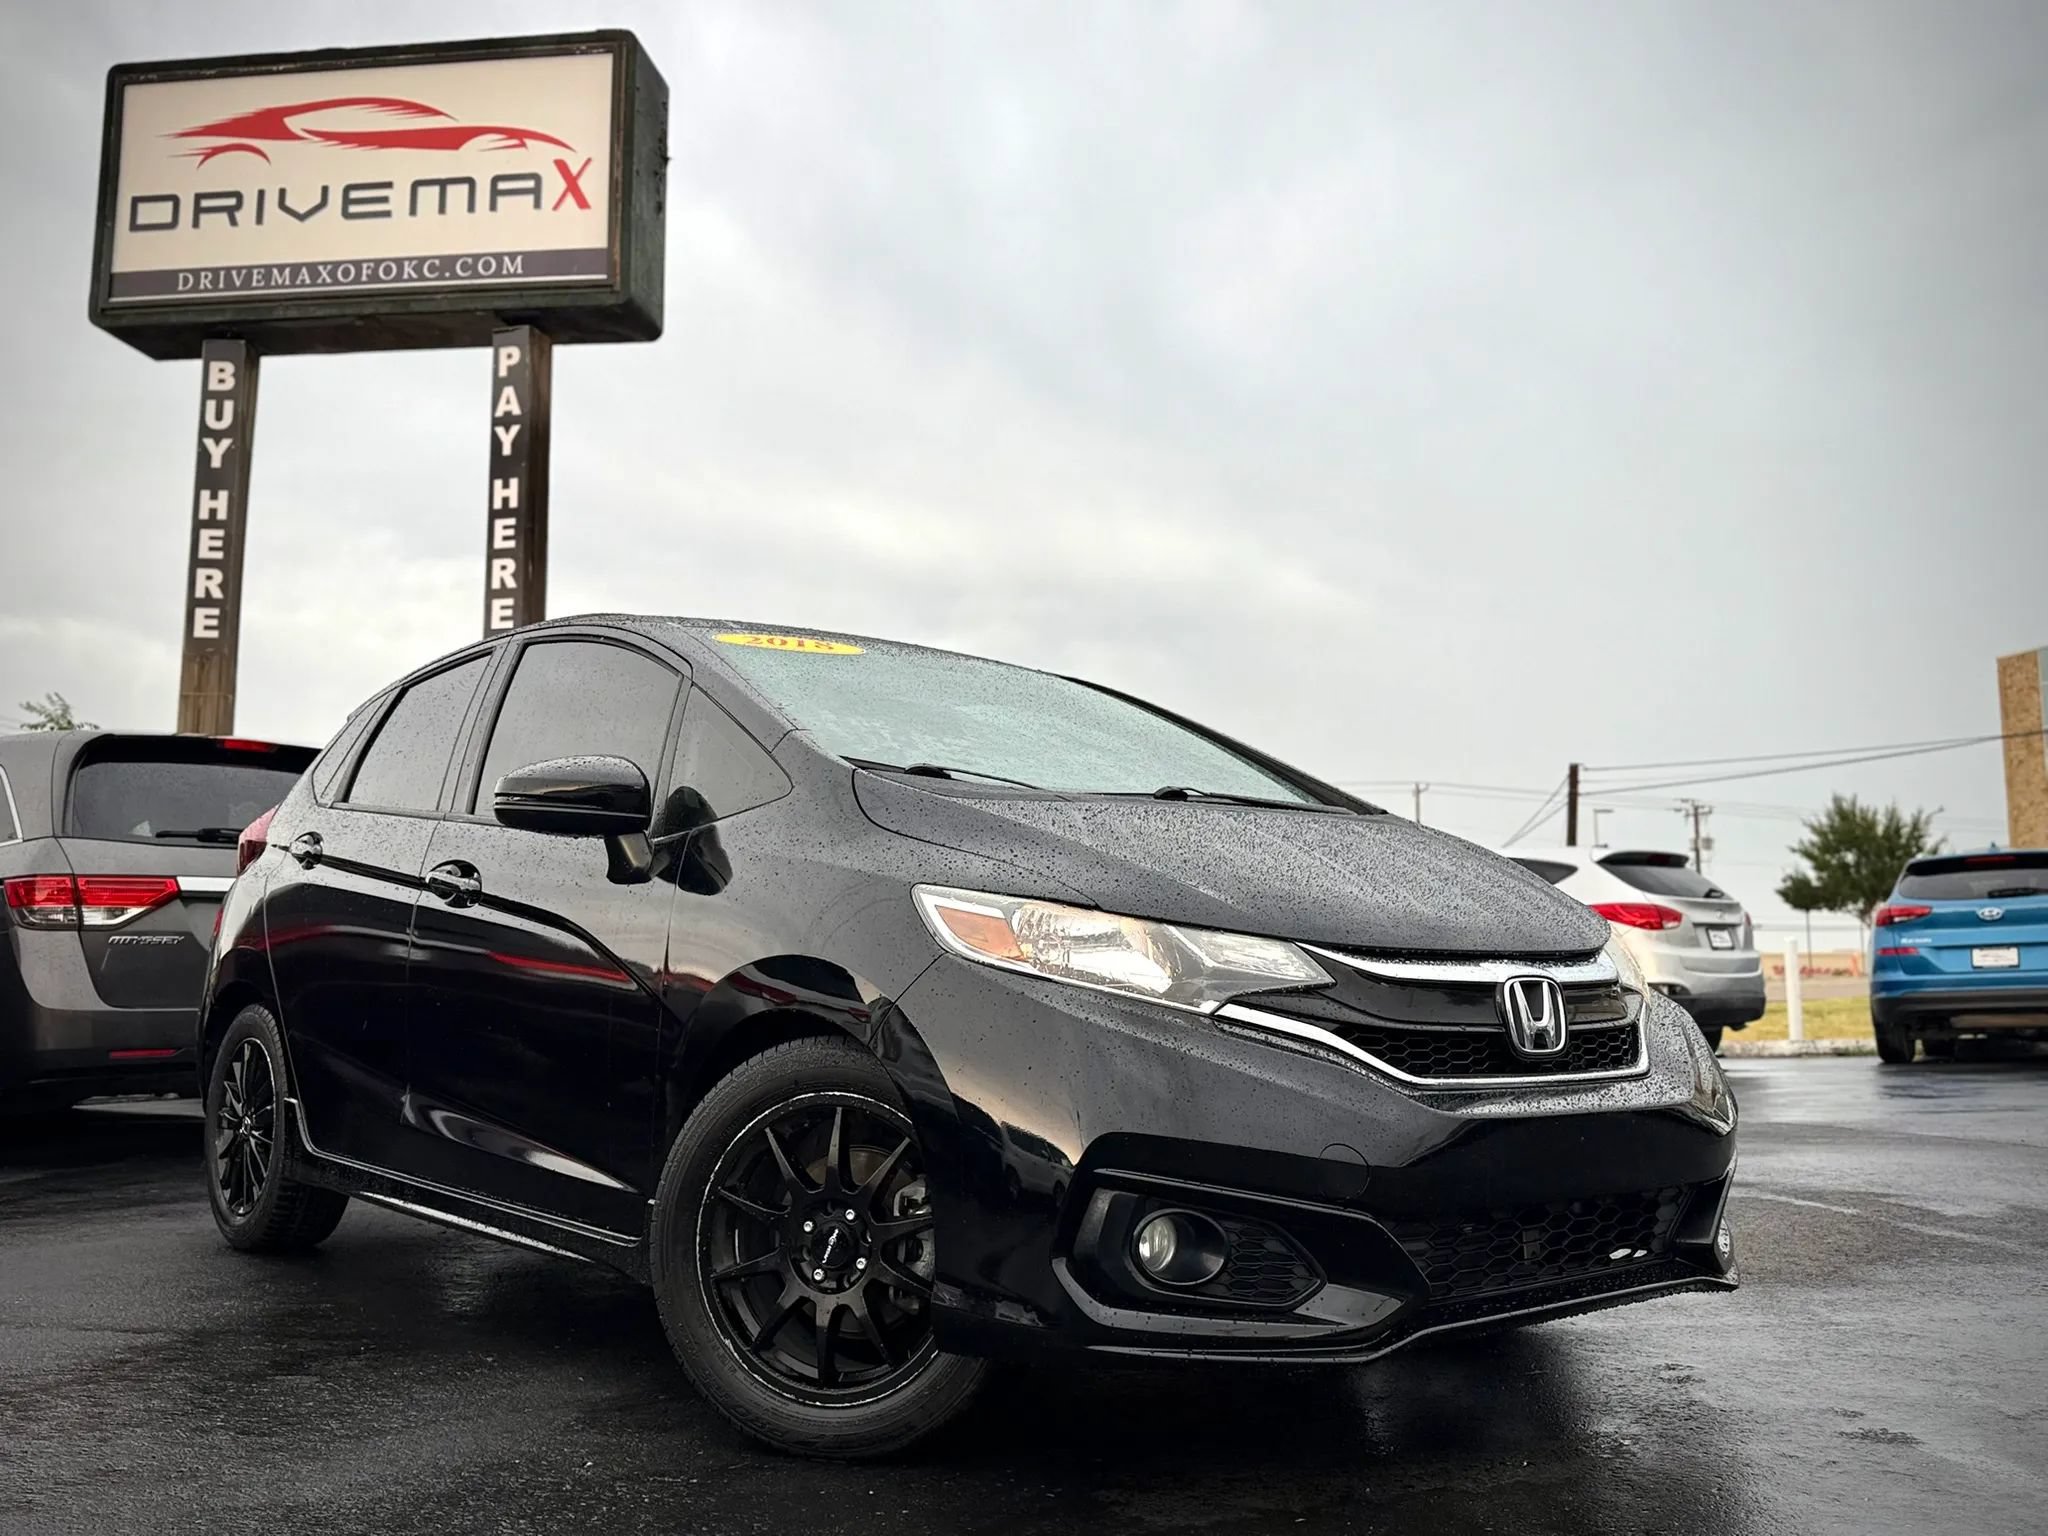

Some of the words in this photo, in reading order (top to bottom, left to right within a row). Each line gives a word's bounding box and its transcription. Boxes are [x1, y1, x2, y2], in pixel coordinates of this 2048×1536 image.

[129, 157, 592, 232] DRIVEMAX
[177, 255, 525, 292] DRIVEMAXOFOKC.COM
[202, 360, 236, 468] BUY
[494, 346, 522, 456] PAY
[192, 490, 229, 639] HERE
[490, 477, 519, 630] HERE
